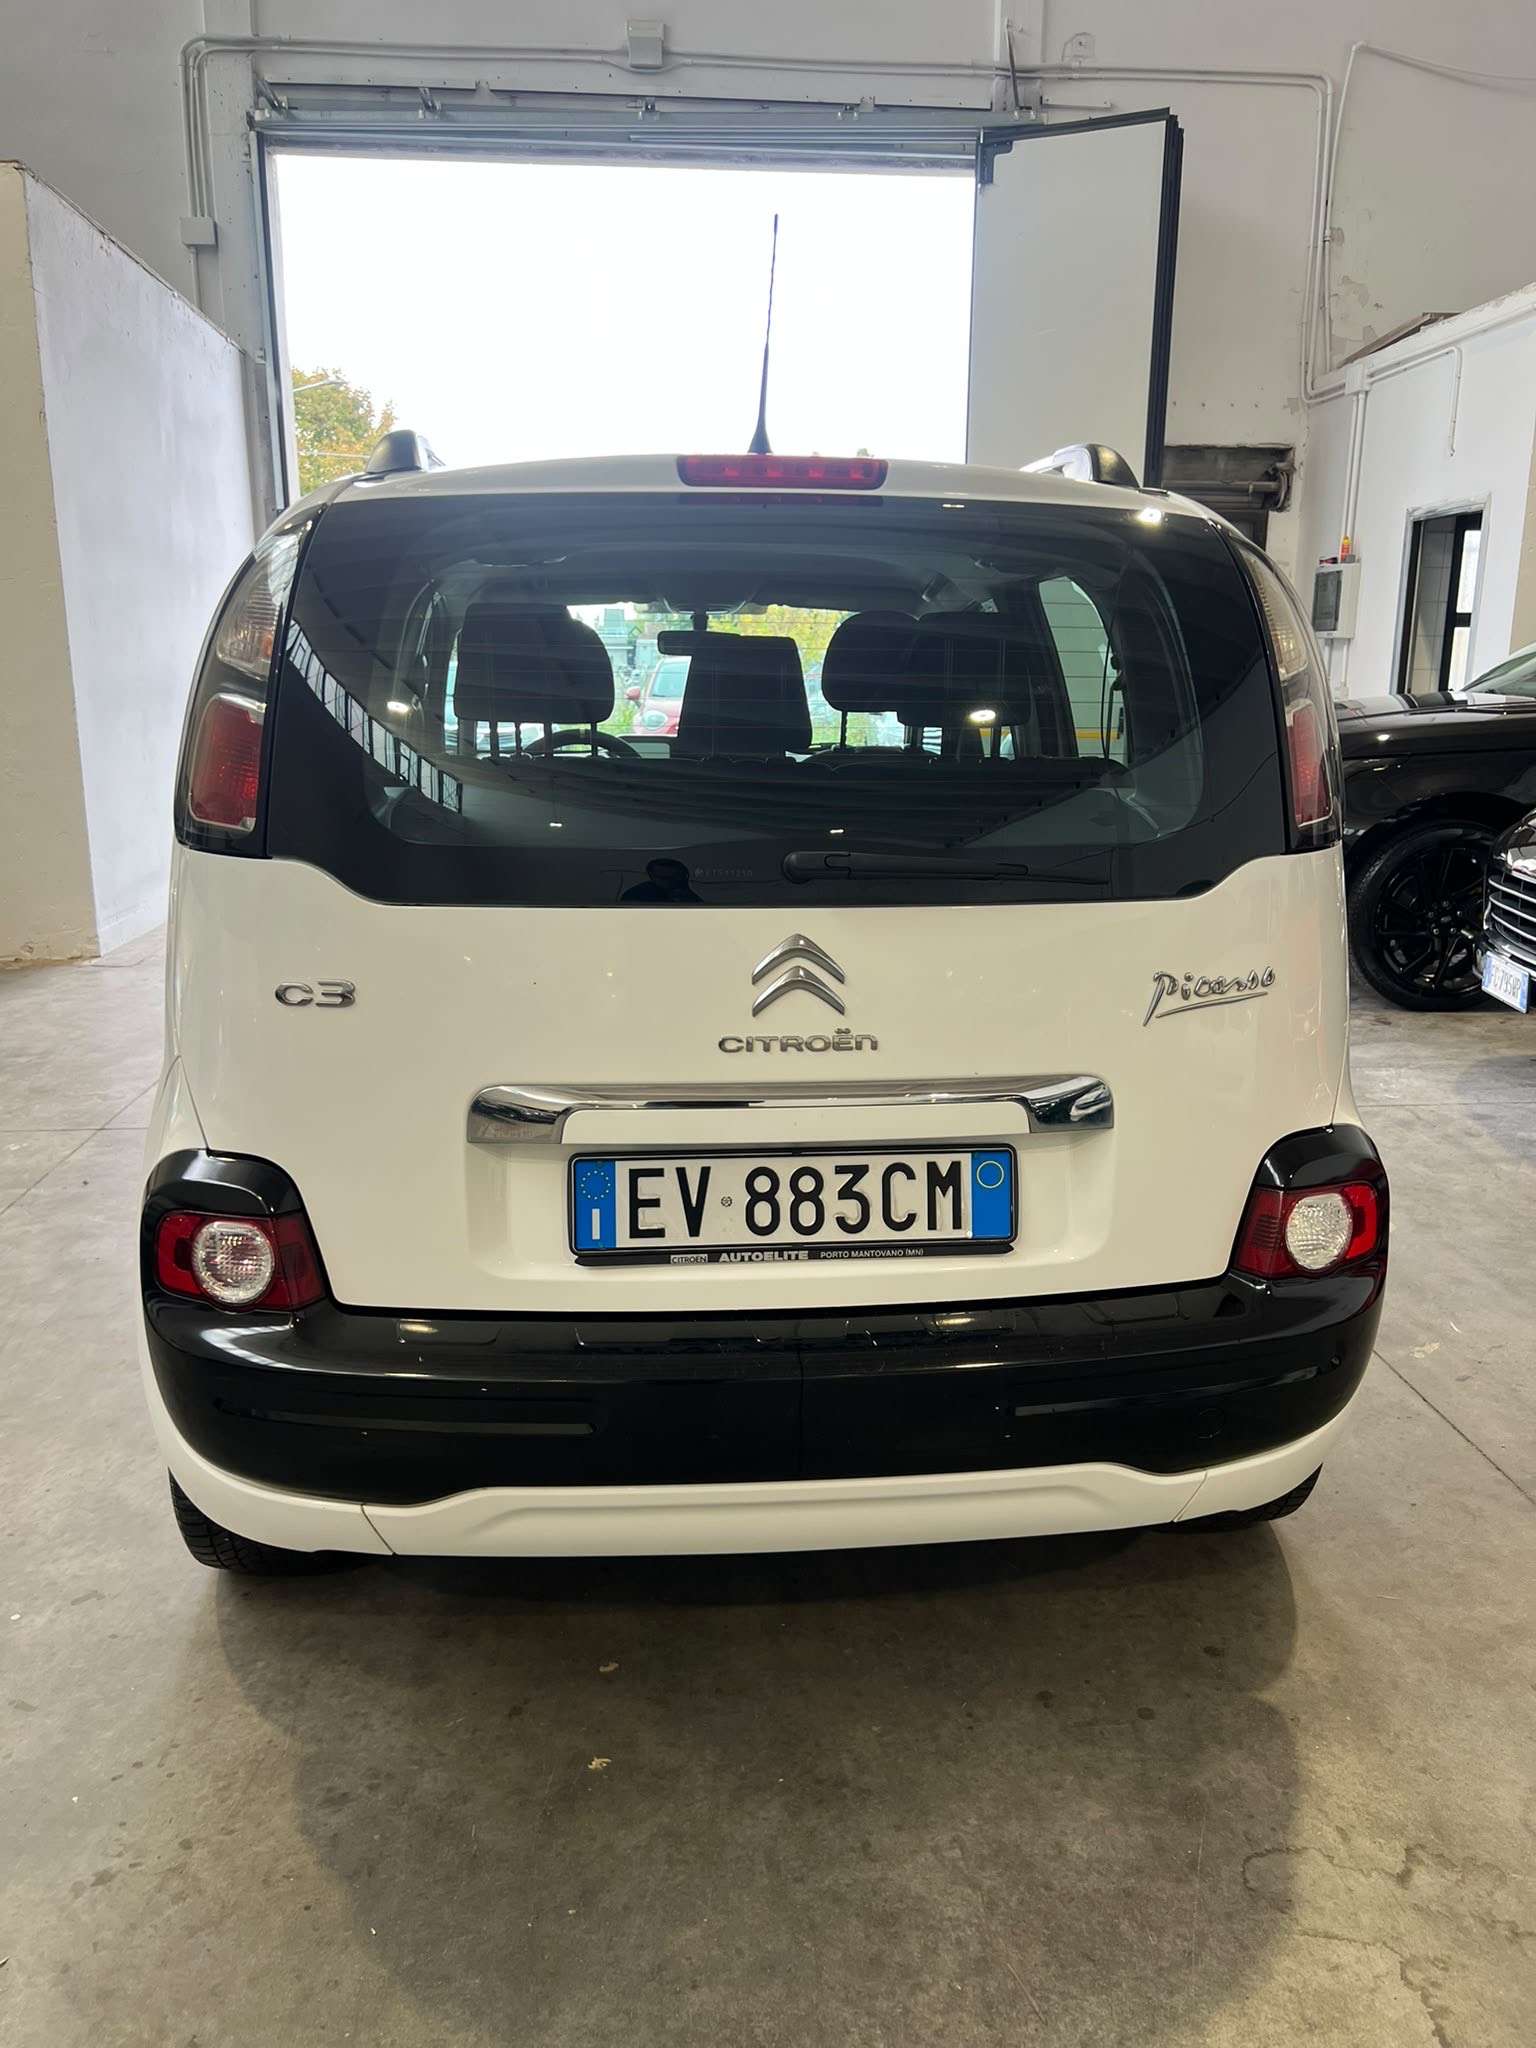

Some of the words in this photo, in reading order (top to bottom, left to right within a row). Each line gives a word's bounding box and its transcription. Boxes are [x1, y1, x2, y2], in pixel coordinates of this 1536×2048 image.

[275, 980, 356, 1008] C3
[1142, 965, 1276, 1027] Picasso
[718, 1250, 809, 1263] AUTOELITE
[820, 1250, 849, 1259] PORTO
[851, 1248, 904, 1258] MANTOVANO
[905, 1247, 924, 1257] (MN)
